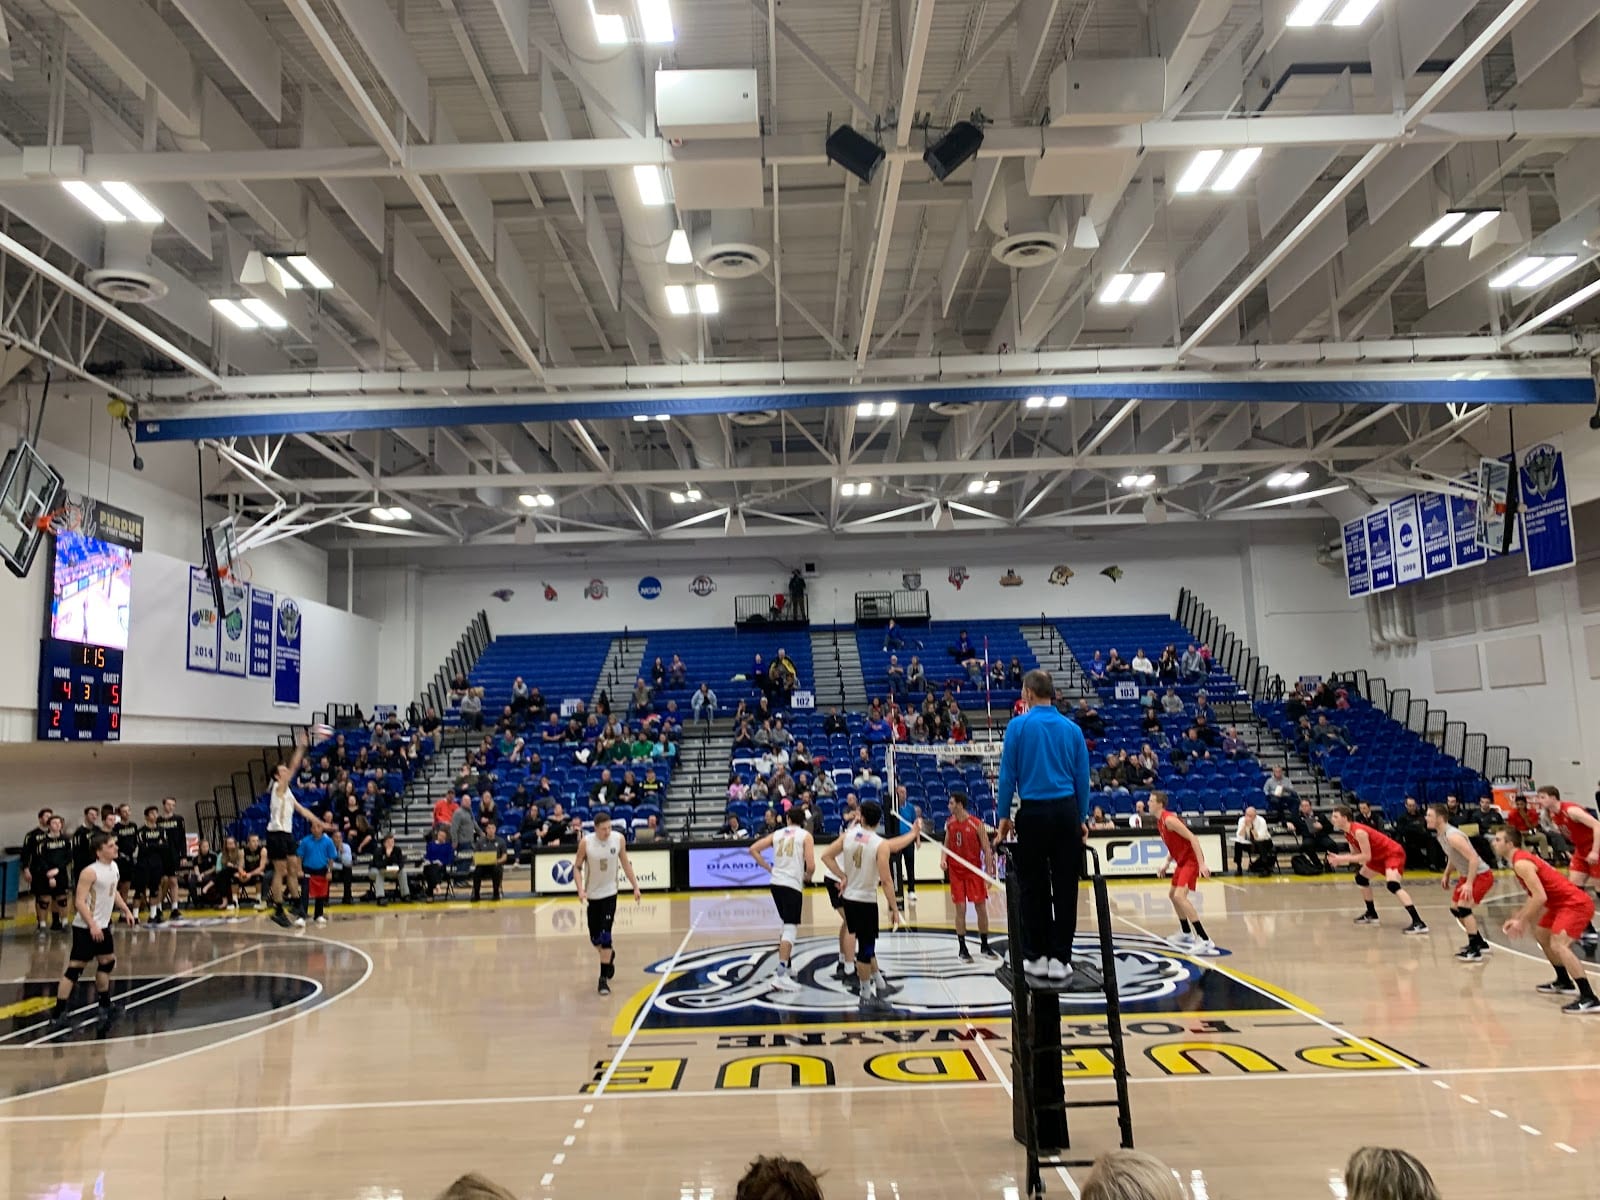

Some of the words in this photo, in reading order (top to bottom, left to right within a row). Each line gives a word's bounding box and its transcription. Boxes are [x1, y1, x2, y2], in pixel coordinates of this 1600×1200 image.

[100, 511, 141, 537] PURDUE
[640, 586, 661, 595] NCAA
[83, 647, 105, 668] 1:15
[195, 646, 213, 658] 2014
[225, 650, 241, 663] 2011
[54, 666, 70, 679] HOME
[103, 672, 119, 684] GUEST
[63, 681, 71, 700] 4
[84, 684, 90, 700] 3
[111, 685, 119, 704] 5
[1120, 688, 1134, 697] 103
[796, 697, 810, 706] 102
[53, 710, 60, 726] 2
[111, 713, 118, 728] 0
[776, 837, 795, 858] 14
[852, 845, 863, 869] 4
[600, 858, 608, 872] 5
[706, 861, 774, 870] DIAMO
[1061, 1020, 1241, 1038] FOR
[717, 1027, 1008, 1048] WAYNE
